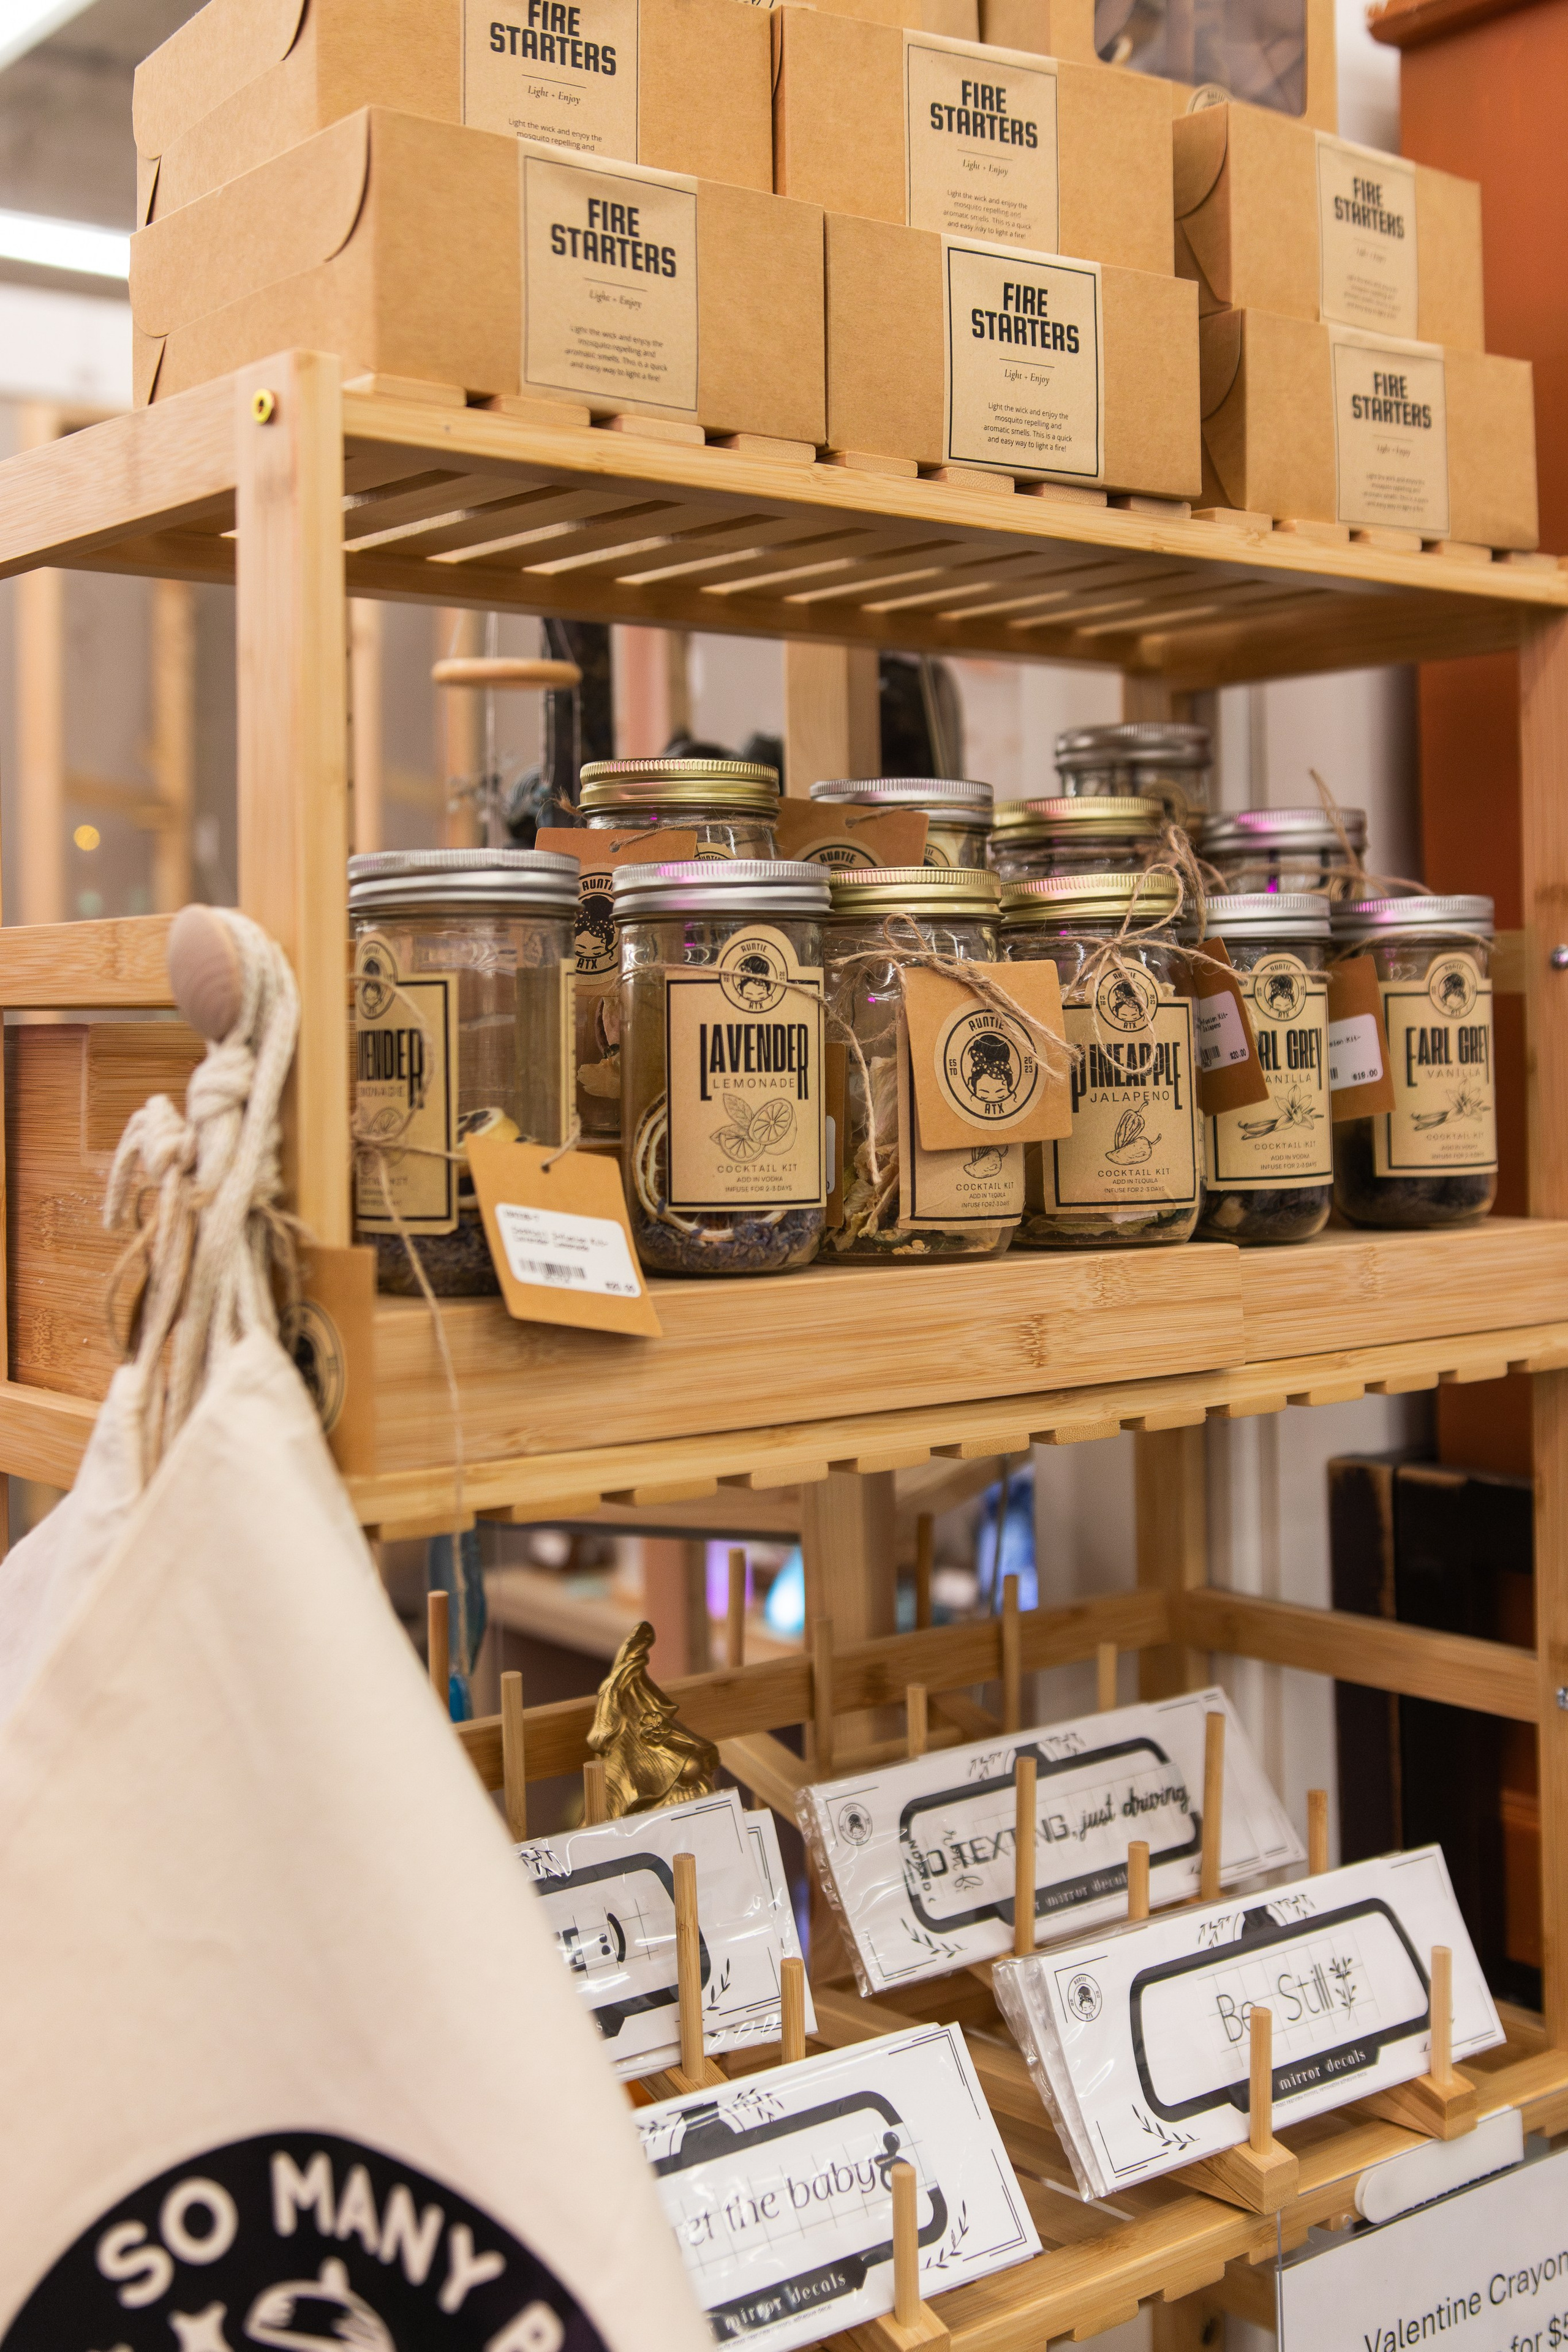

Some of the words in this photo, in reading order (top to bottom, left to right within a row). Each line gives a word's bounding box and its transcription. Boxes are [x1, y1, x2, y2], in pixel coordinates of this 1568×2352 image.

[528, 0, 580, 37] FIRE
[490, 22, 616, 76] STARTERS
[528, 85, 549, 98] Light
[558, 91, 581, 106] Enjoy
[962, 80, 1006, 114] FIRE
[508, 118, 526, 127] Light
[527, 121, 538, 130] the
[557, 127, 570, 136] and
[572, 131, 590, 141] enjoy
[930, 102, 1038, 148] STARTERS
[516, 132, 549, 143] mosquito
[552, 137, 581, 150] repelling
[963, 159, 979, 171] Light
[989, 164, 1008, 178] Enjoy
[1001, 200, 1017, 209] enjoy
[1353, 176, 1382, 208] FIRE
[588, 198, 639, 238] FIRE
[954, 202, 981, 211] mosquito
[983, 205, 1009, 217] repelling
[1335, 195, 1405, 239] STARTERS
[1017, 222, 1031, 231] quick
[551, 223, 676, 277] STARTERS
[1003, 282, 1048, 317] FIRE
[972, 308, 1079, 354] STARTERS
[1005, 369, 1022, 382] Light
[1030, 372, 1050, 386] Enjoy
[1374, 371, 1408, 399] FIRE
[989, 402, 1003, 411] Light
[1042, 411, 1058, 420] enjoy
[995, 415, 1023, 425] mosquito
[1024, 419, 1049, 429] repelling
[1352, 394, 1432, 429] STARTERS
[984, 424, 1009, 434] aromatic
[1057, 434, 1072, 443] quick
[1016, 440, 1027, 449] way
[1036, 442, 1048, 451] light
[819, 850, 856, 864] AUNTIE
[582, 878, 612, 891] AUNTI
[741, 943, 767, 952] AUNTIE
[576, 958, 597, 970] ATX
[968, 1016, 1005, 1031] AUNTIE
[700, 1023, 809, 1101] LAVENDER
[1257, 1030, 1281, 1071] RL
[1286, 1028, 1322, 1091] GREY
[1406, 1026, 1452, 1087] EARL
[714, 1078, 794, 1088] LEMONADE
[1071, 1042, 1183, 1113] PINEAPPLE
[1265, 1074, 1311, 1084] ANILLA
[984, 1103, 1005, 1114] ATX
[1090, 1090, 1169, 1103] JALAPENO
[717, 1164, 777, 1173] COCKTAIL
[950, 1815, 1077, 1868] TEXNG,
[1080, 1793, 1115, 1841] just
[1122, 1787, 1190, 1817] driving
[1278, 1963, 1334, 2021] Still
[1279, 2067, 1320, 2090] mirror
[1325, 2049, 1366, 2073] decals
[726, 2192, 780, 2232] the
[787, 2158, 876, 2209] baby
[97, 2176, 238, 2309] SO
[270, 2150, 506, 2314] MANY
[725, 2297, 781, 2330] mirror
[791, 2272, 846, 2304] decals
[1365, 2292, 1482, 2352] Valentine
[1511, 2332, 1542, 2352] for
